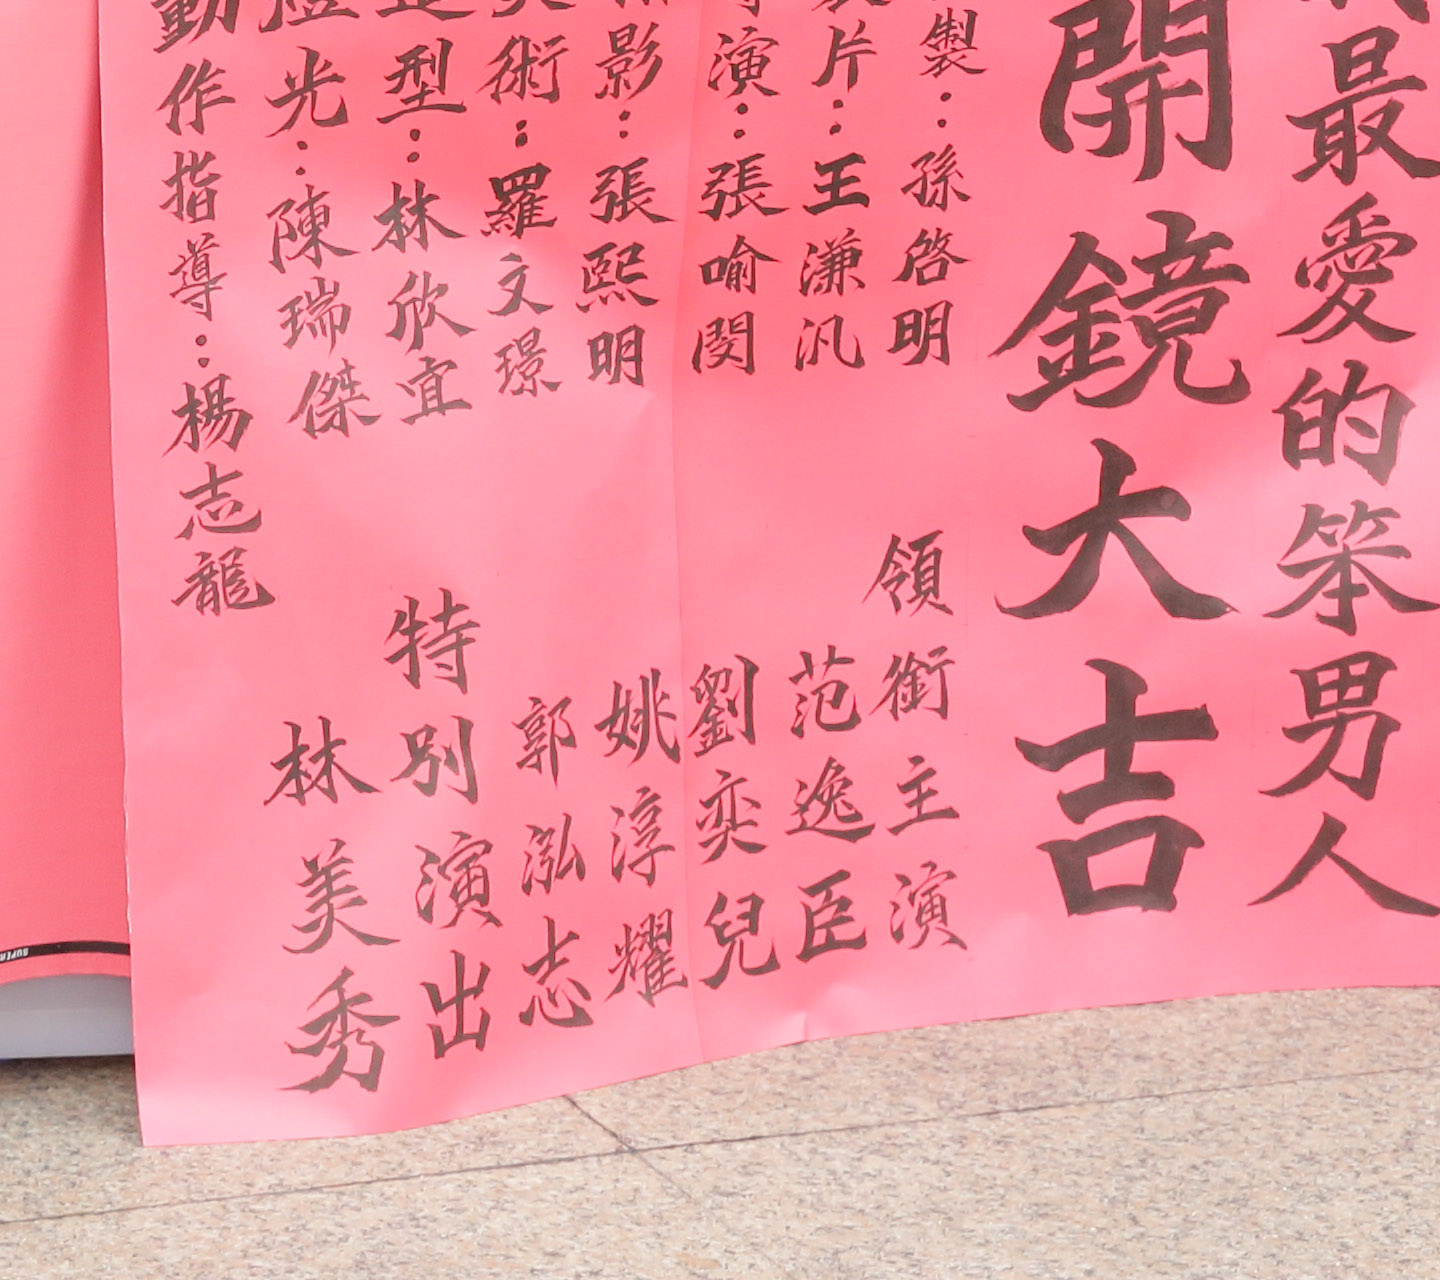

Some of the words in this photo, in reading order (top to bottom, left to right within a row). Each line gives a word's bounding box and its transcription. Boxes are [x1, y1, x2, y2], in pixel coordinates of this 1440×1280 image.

[264, 716, 400, 1093] 林美秀
[385, 588, 502, 1059] 特別演出
[514, 697, 593, 1027] 郭泓志
[594, 668, 688, 1006] 姚淳耀
[690, 655, 780, 989] 劉奕兒
[786, 645, 875, 963] 范逸臣
[869, 530, 967, 949] 領銜主演
[0, 948, 28, 961] SUPER
